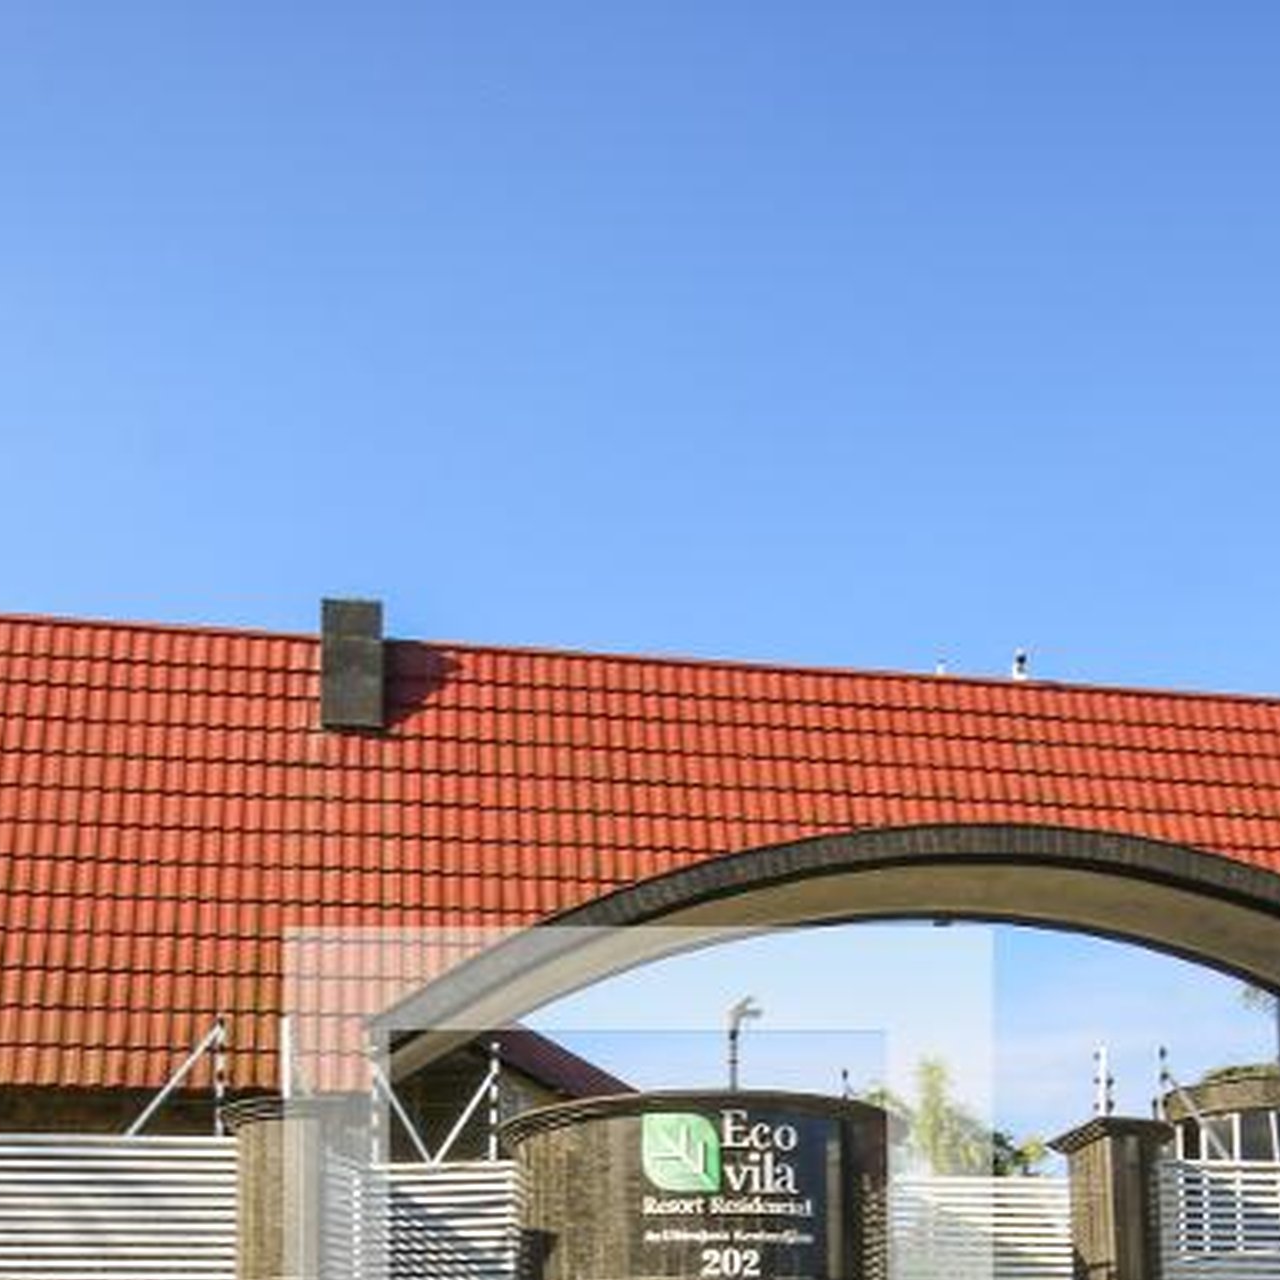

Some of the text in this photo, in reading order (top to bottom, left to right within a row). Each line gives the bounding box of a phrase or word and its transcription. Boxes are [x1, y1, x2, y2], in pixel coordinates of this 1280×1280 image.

[720, 1109, 798, 1151] Eco
[723, 1151, 799, 1194] vila
[642, 1195, 704, 1214] Resort
[701, 1249, 761, 1278] 202
